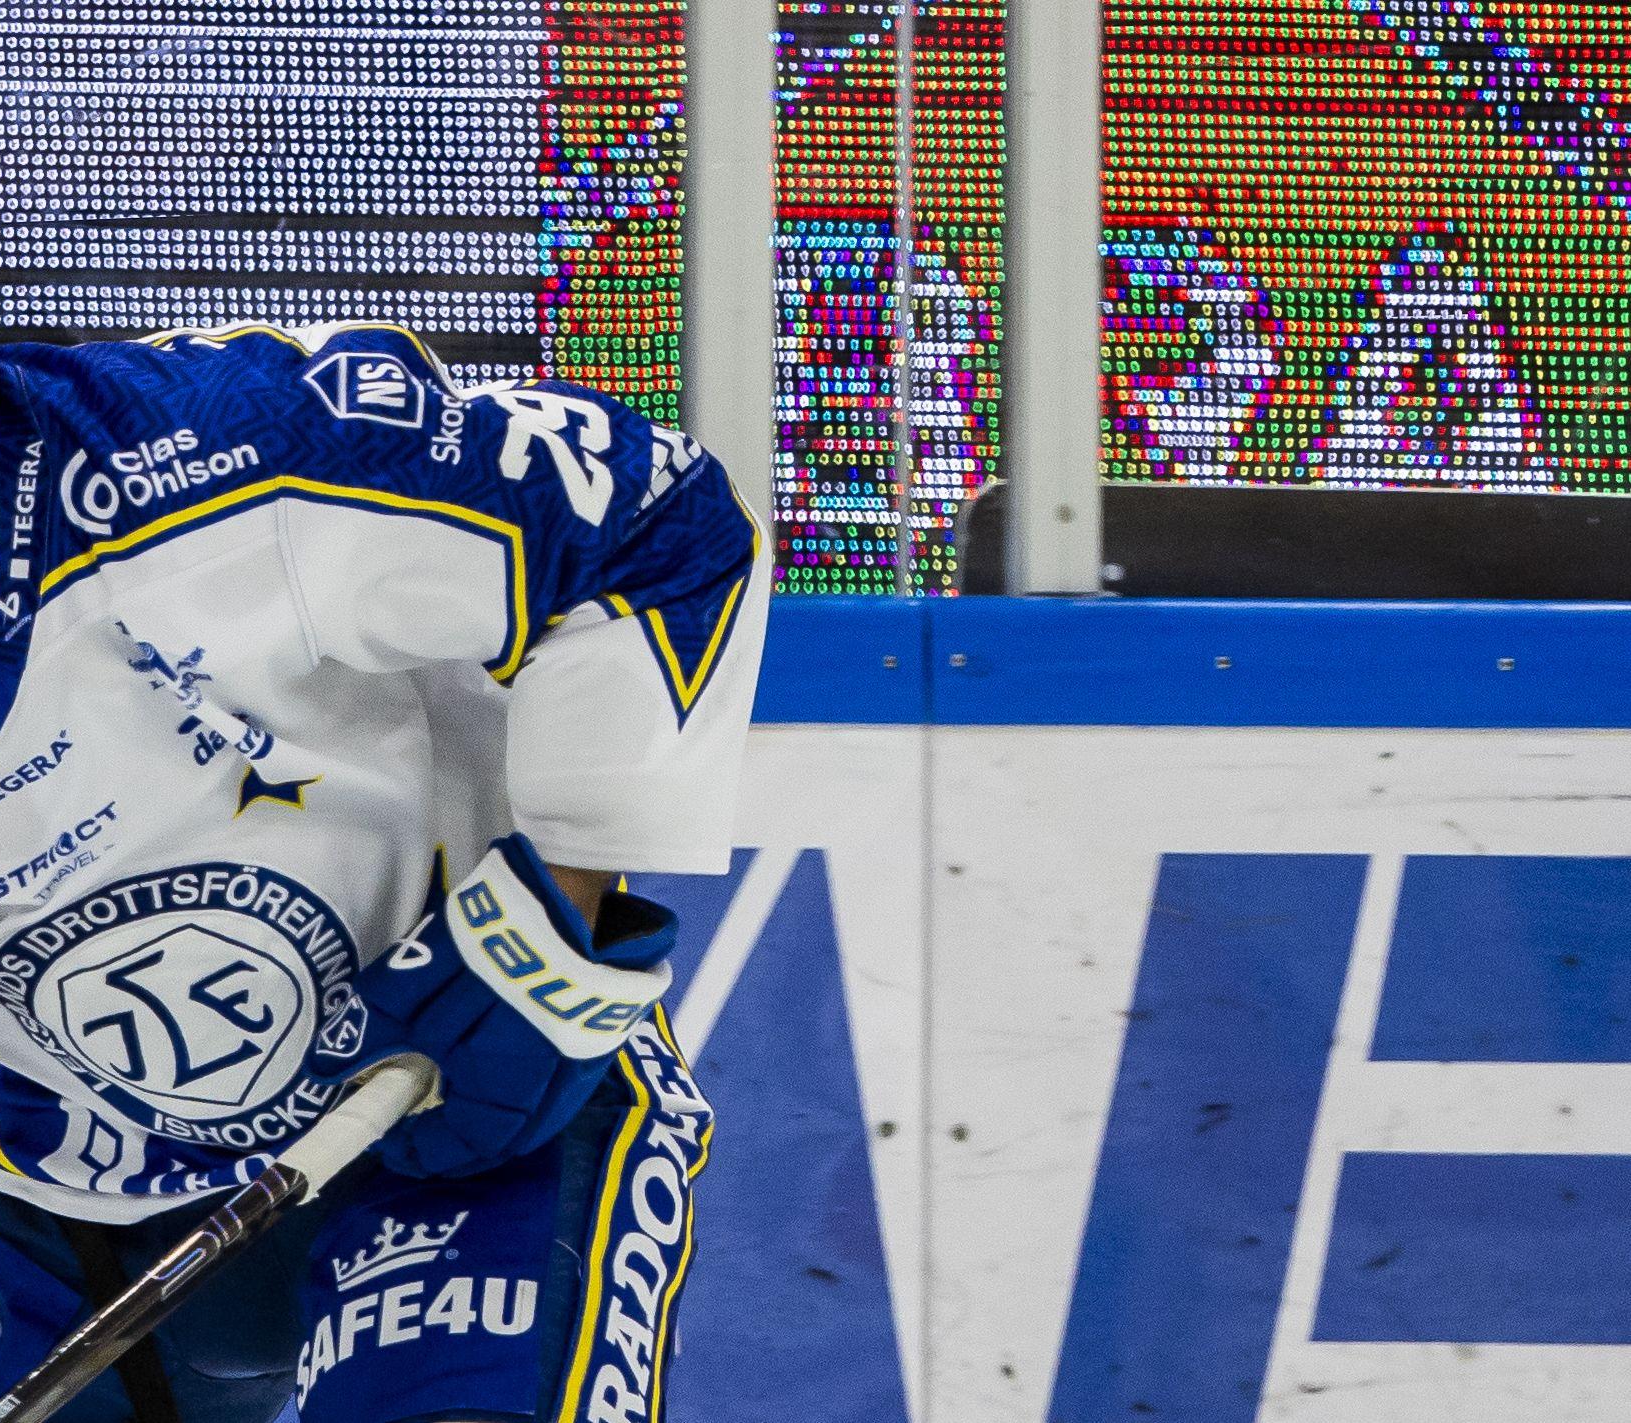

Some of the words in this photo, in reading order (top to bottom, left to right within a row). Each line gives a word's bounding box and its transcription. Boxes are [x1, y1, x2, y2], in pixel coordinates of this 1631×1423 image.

[12, 439, 44, 549] TEGERA
[110, 428, 199, 473] Clas
[121, 440, 260, 507] Ohlson
[20, 865, 354, 1017] IDROTTSFÖRENING
[153, 1078, 335, 1149] ISHOCKE
[295, 1275, 539, 1412] SAFE4U
